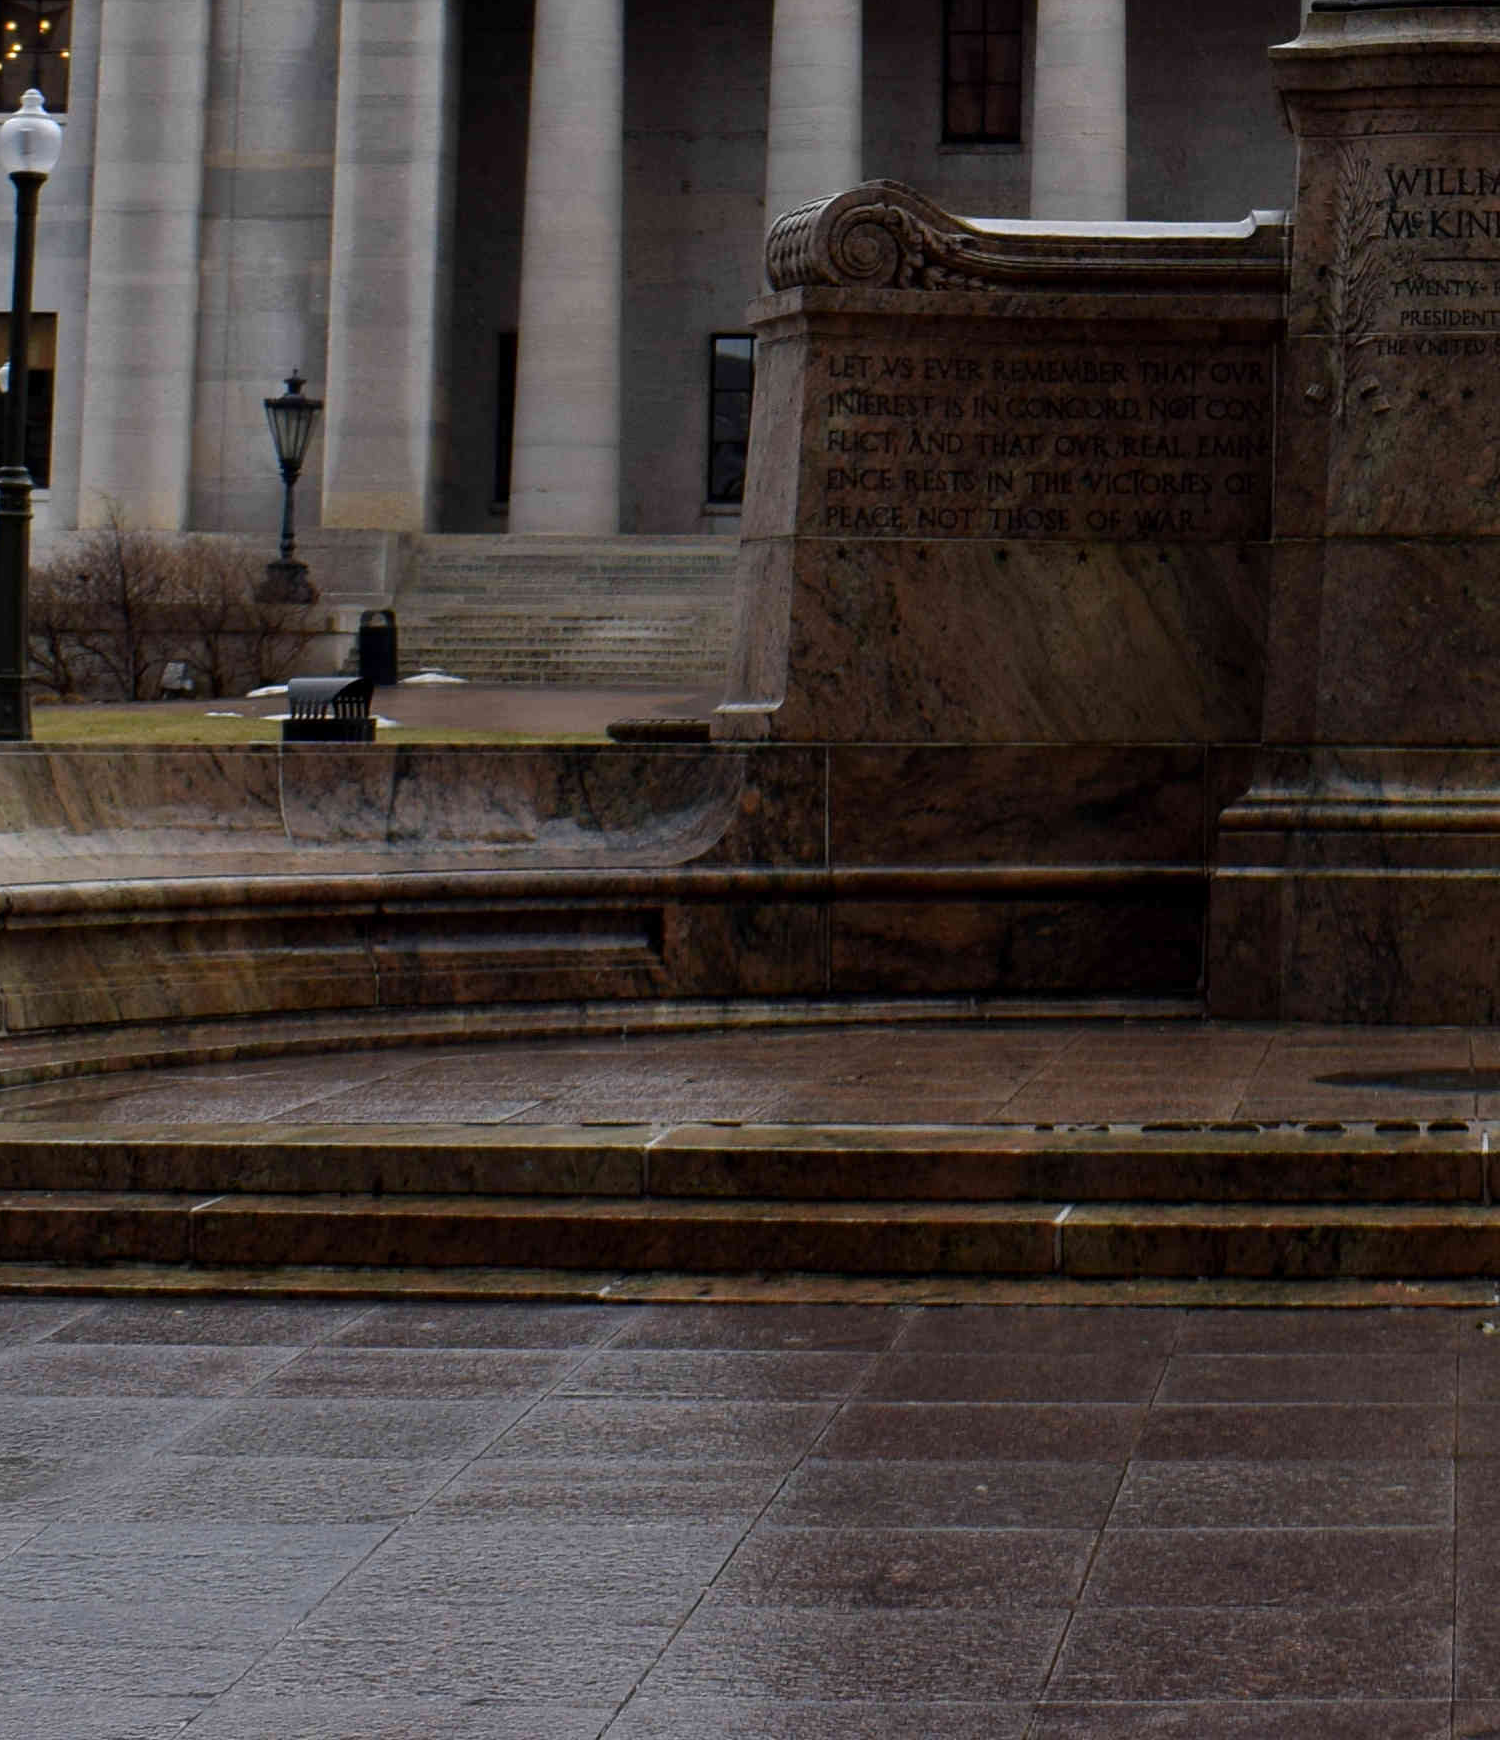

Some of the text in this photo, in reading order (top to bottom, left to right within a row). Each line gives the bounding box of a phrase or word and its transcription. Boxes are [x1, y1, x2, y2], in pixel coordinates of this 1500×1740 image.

[1400, 310, 1500, 326] PRESIDENT
[1377, 339, 1406, 356] THE
[829, 356, 871, 378] LET
[923, 359, 981, 381] EVER
[993, 360, 1127, 382] REMEMBER
[1141, 361, 1199, 383] THAT
[827, 390, 932, 417] INTEREST
[945, 397, 963, 418] IS
[974, 397, 998, 419] IN
[1150, 396, 1203, 420] NOT
[908, 431, 963, 453] AND
[975, 433, 1043, 456] THAT
[1122, 436, 1185, 459] REAL
[827, 468, 1259, 495] ENCE RESTS IN THE VICTORIES OF
[917, 507, 976, 530] NOT
[988, 508, 1070, 532] THOSE
[1085, 509, 1122, 532] OF
